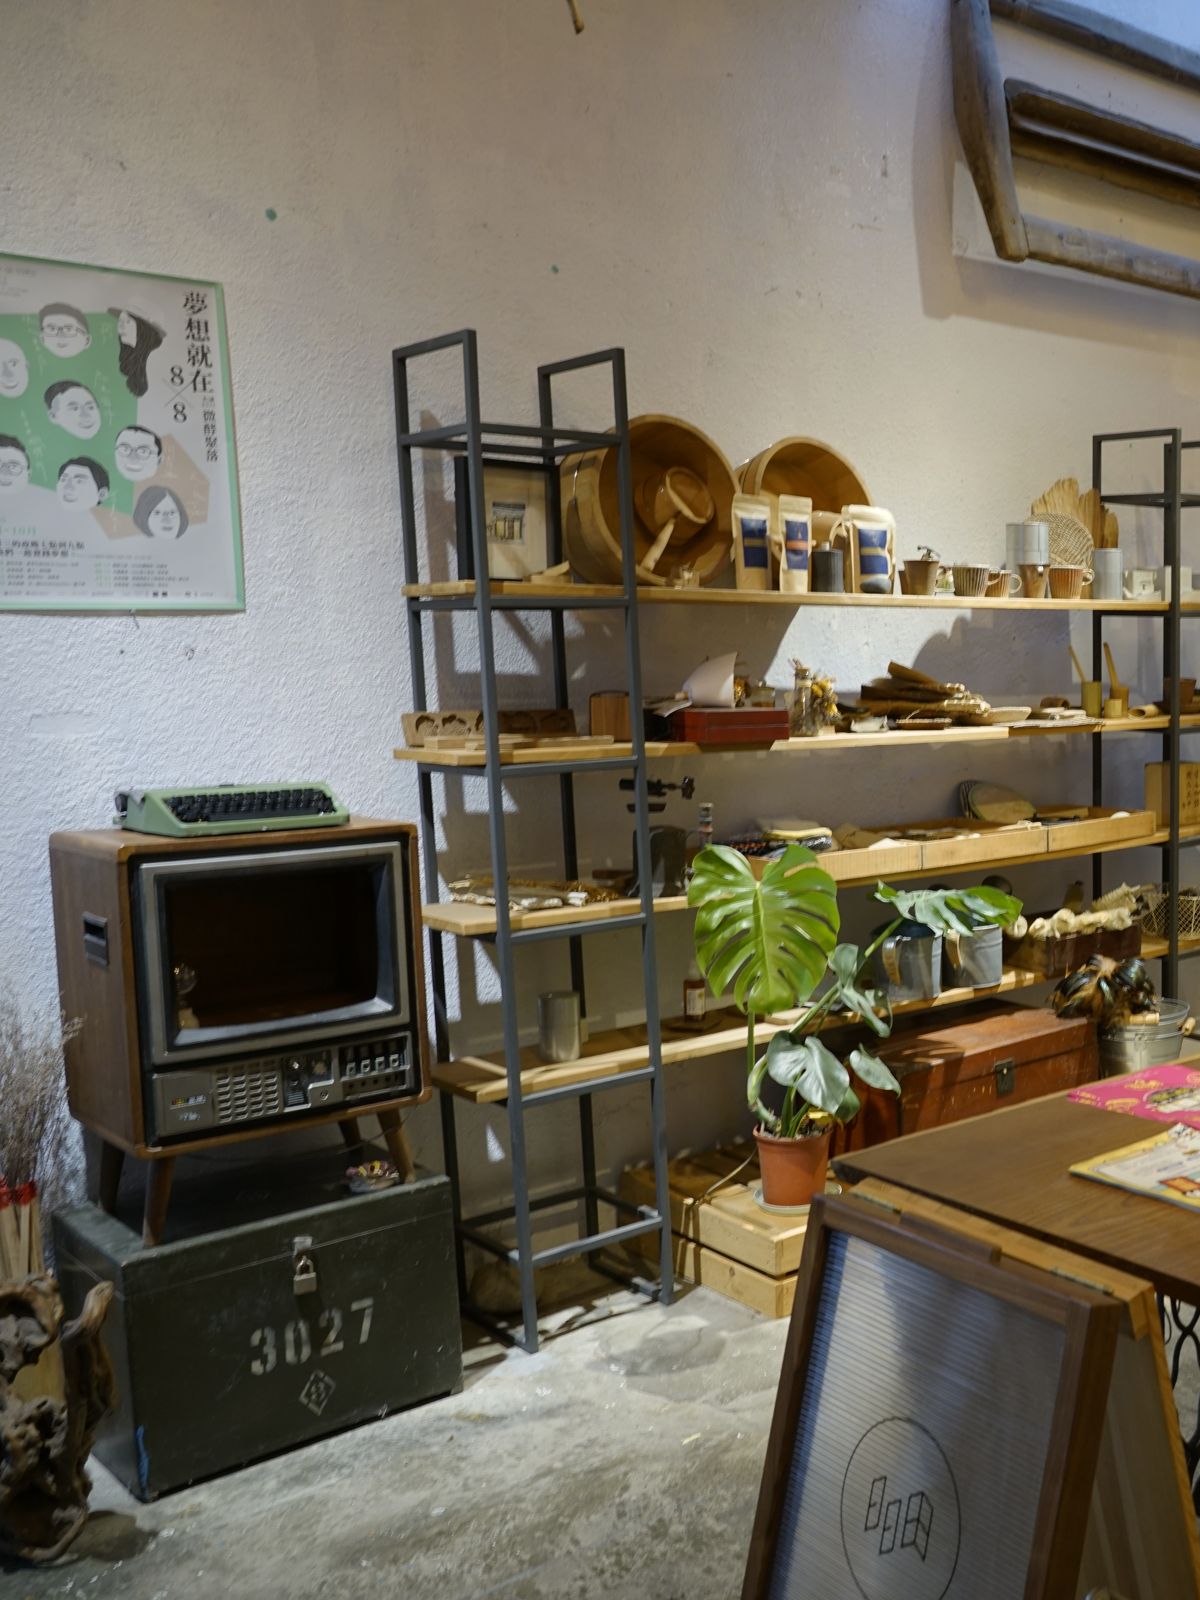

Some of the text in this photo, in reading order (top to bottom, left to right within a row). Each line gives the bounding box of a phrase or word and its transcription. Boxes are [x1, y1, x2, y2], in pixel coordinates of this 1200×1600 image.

[183, 292, 213, 393] 夢想就在
[250, 1297, 374, 1376] 3027
